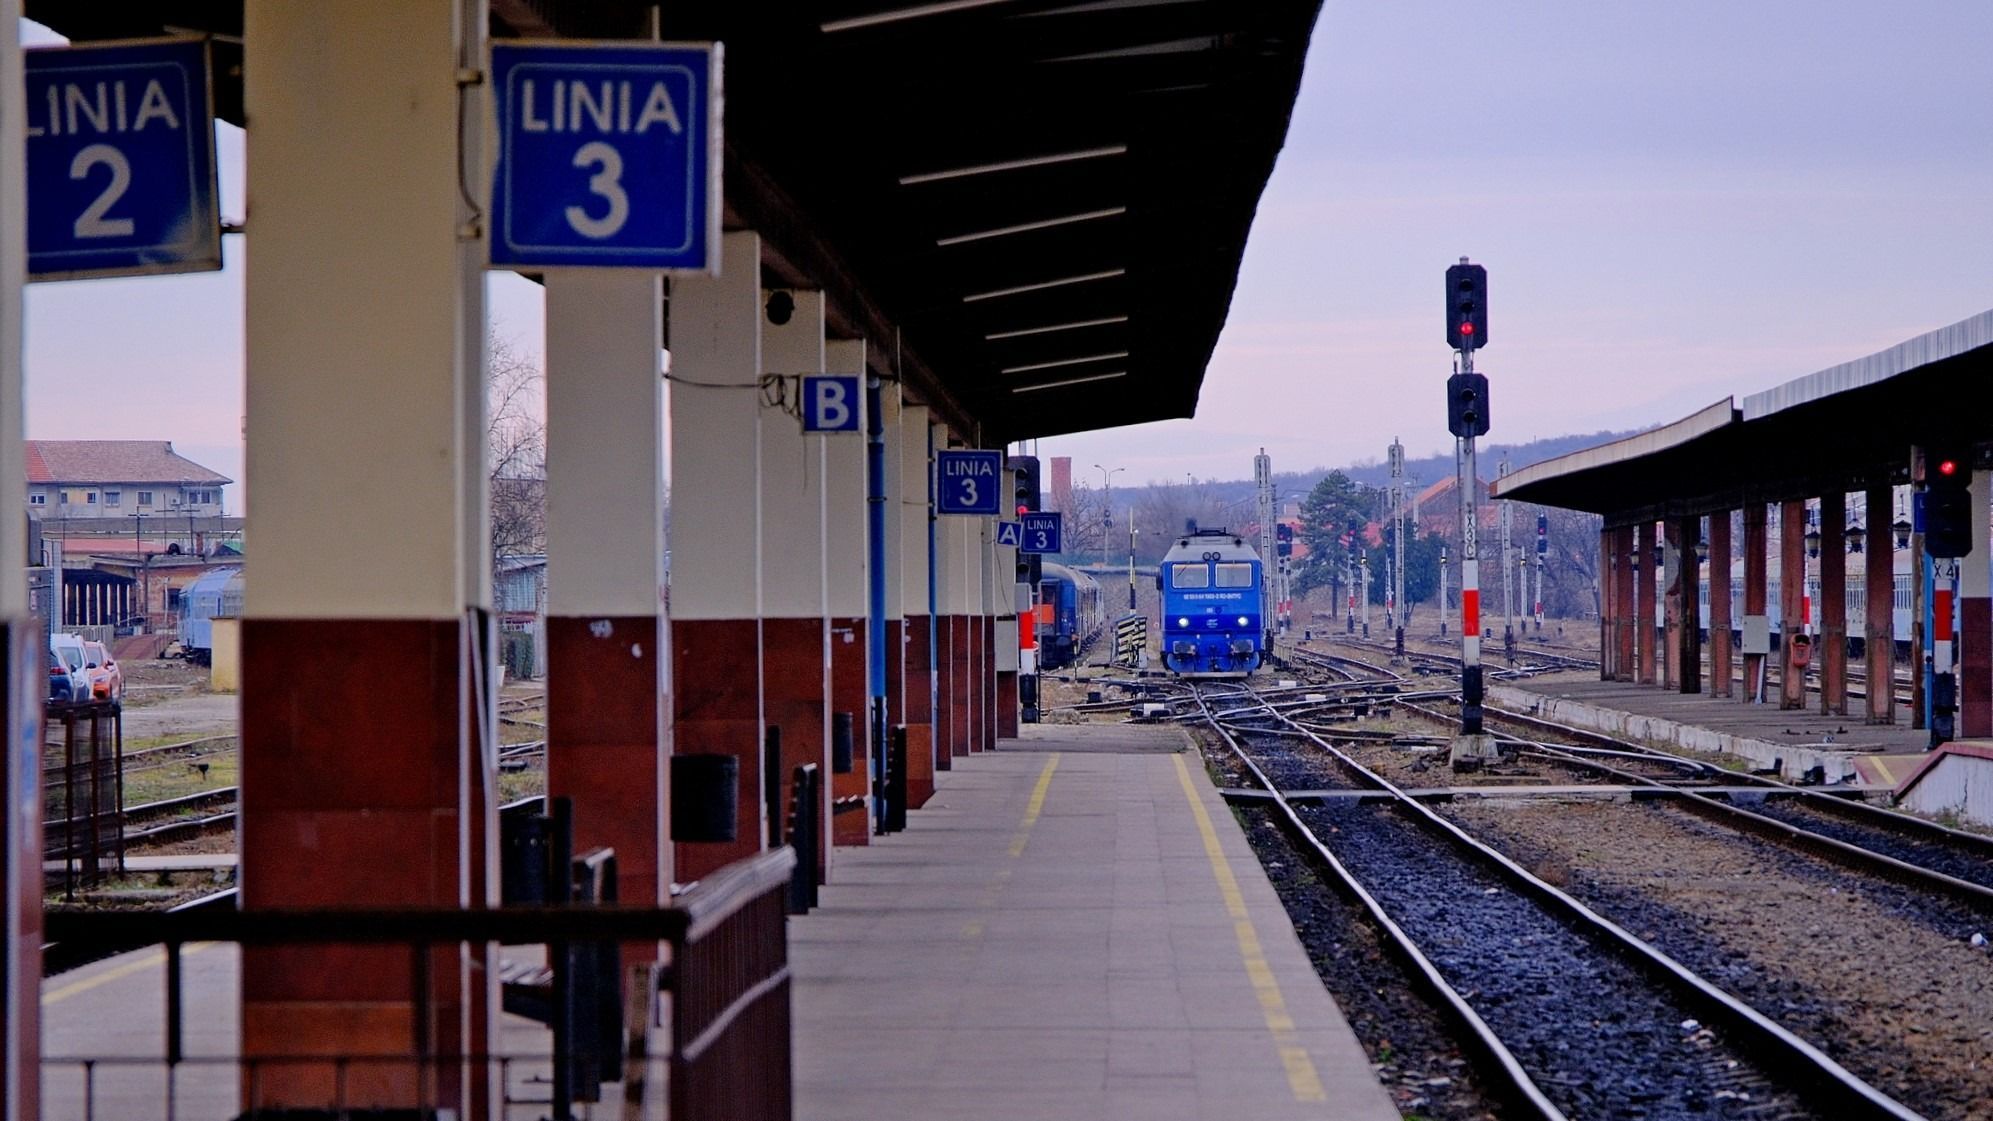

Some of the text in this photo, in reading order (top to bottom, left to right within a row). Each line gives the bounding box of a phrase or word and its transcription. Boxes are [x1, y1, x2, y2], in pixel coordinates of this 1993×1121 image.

[26, 79, 180, 136] INIA
[522, 79, 683, 134] LINIA
[69, 143, 135, 239] 2
[564, 141, 630, 239] 3
[816, 380, 850, 429] B
[946, 460, 993, 476] LINIA
[960, 478, 979, 506] 3
[999, 524, 1018, 545] A
[1027, 519, 1055, 530] LINIA
[1035, 531, 1048, 549] 3
